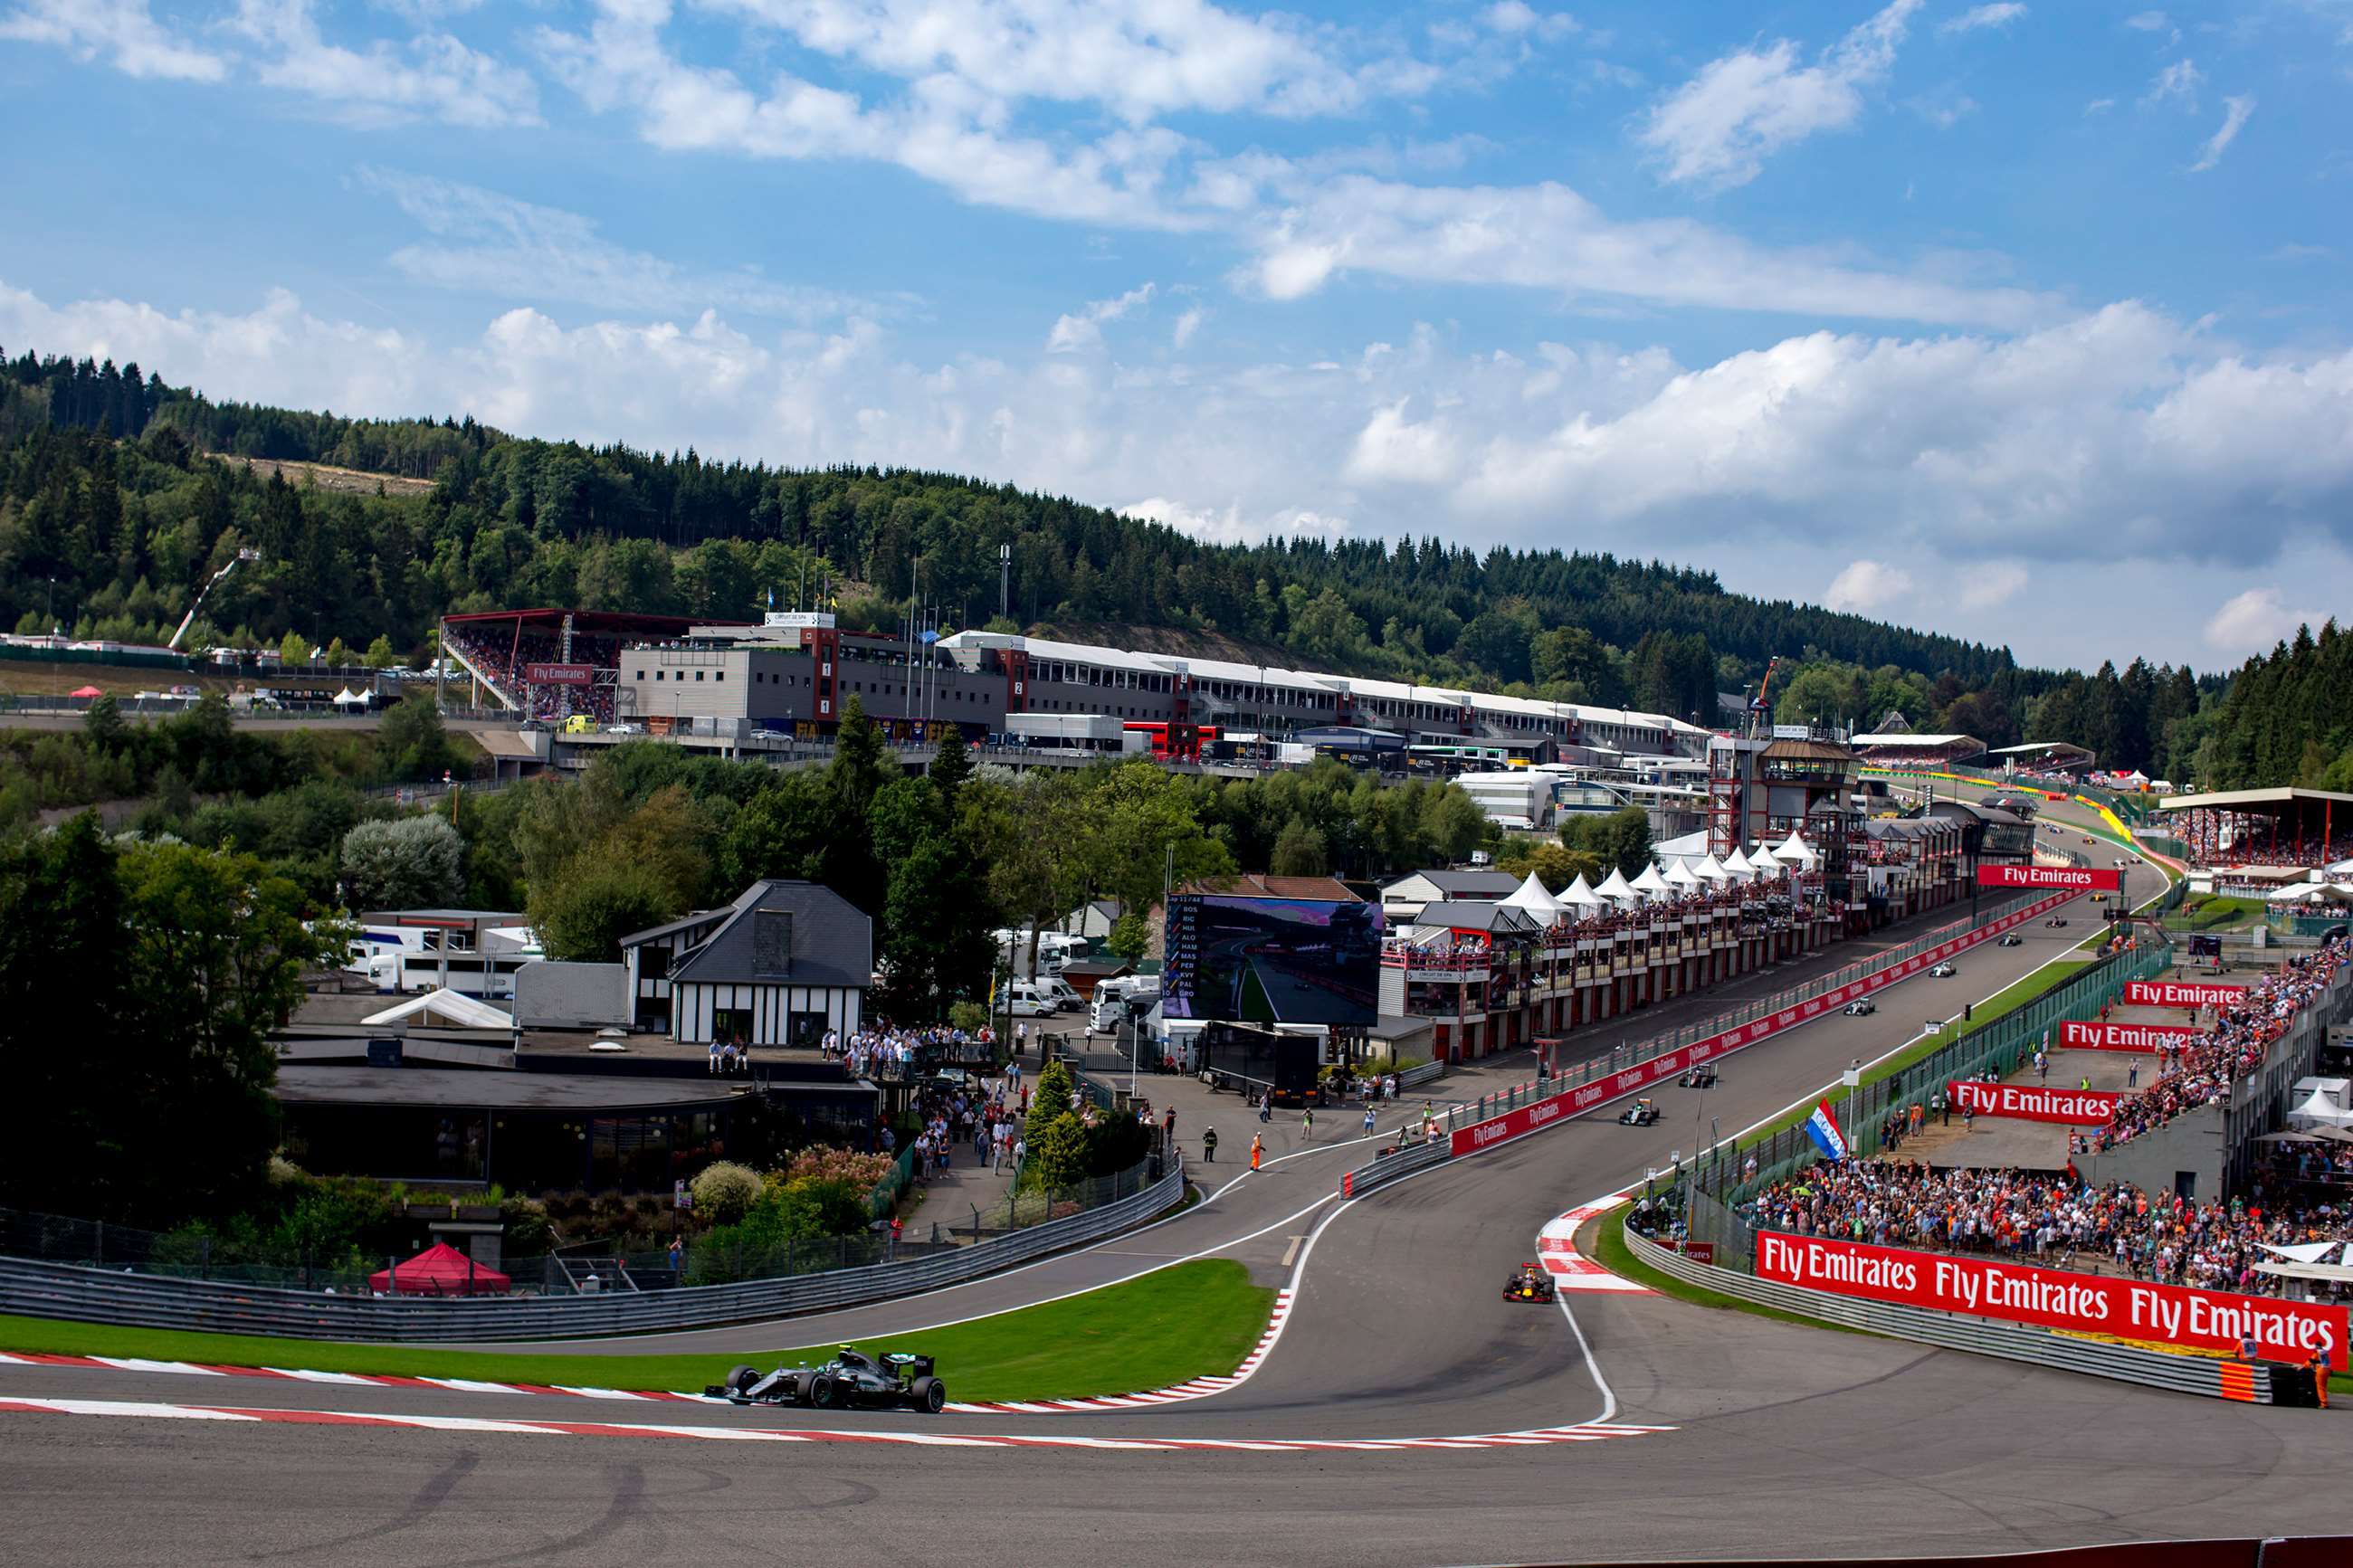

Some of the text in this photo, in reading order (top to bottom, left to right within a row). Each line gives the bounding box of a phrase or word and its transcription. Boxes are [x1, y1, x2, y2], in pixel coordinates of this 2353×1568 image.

[534, 668, 585, 681] Fly Emirates
[1017, 683, 1021, 693] 2
[2004, 868, 2091, 884] Fly Emirates
[2131, 984, 2244, 1004] Fly Emirates
[2068, 1024, 2101, 1047] Fly
[1575, 1086, 1602, 1107] Fly Emirates
[1957, 1085, 2110, 1117] Fly Emirates
[1529, 1103, 1558, 1124] Fly Emirates
[1474, 1122, 1507, 1145] Fly Emirates
[1686, 1250, 1710, 1259] irates
[1765, 1237, 1917, 1291] Fly Emirates
[1936, 1261, 2108, 1320] Fly Emirates
[2130, 1288, 2334, 1351] Fly Emirates
